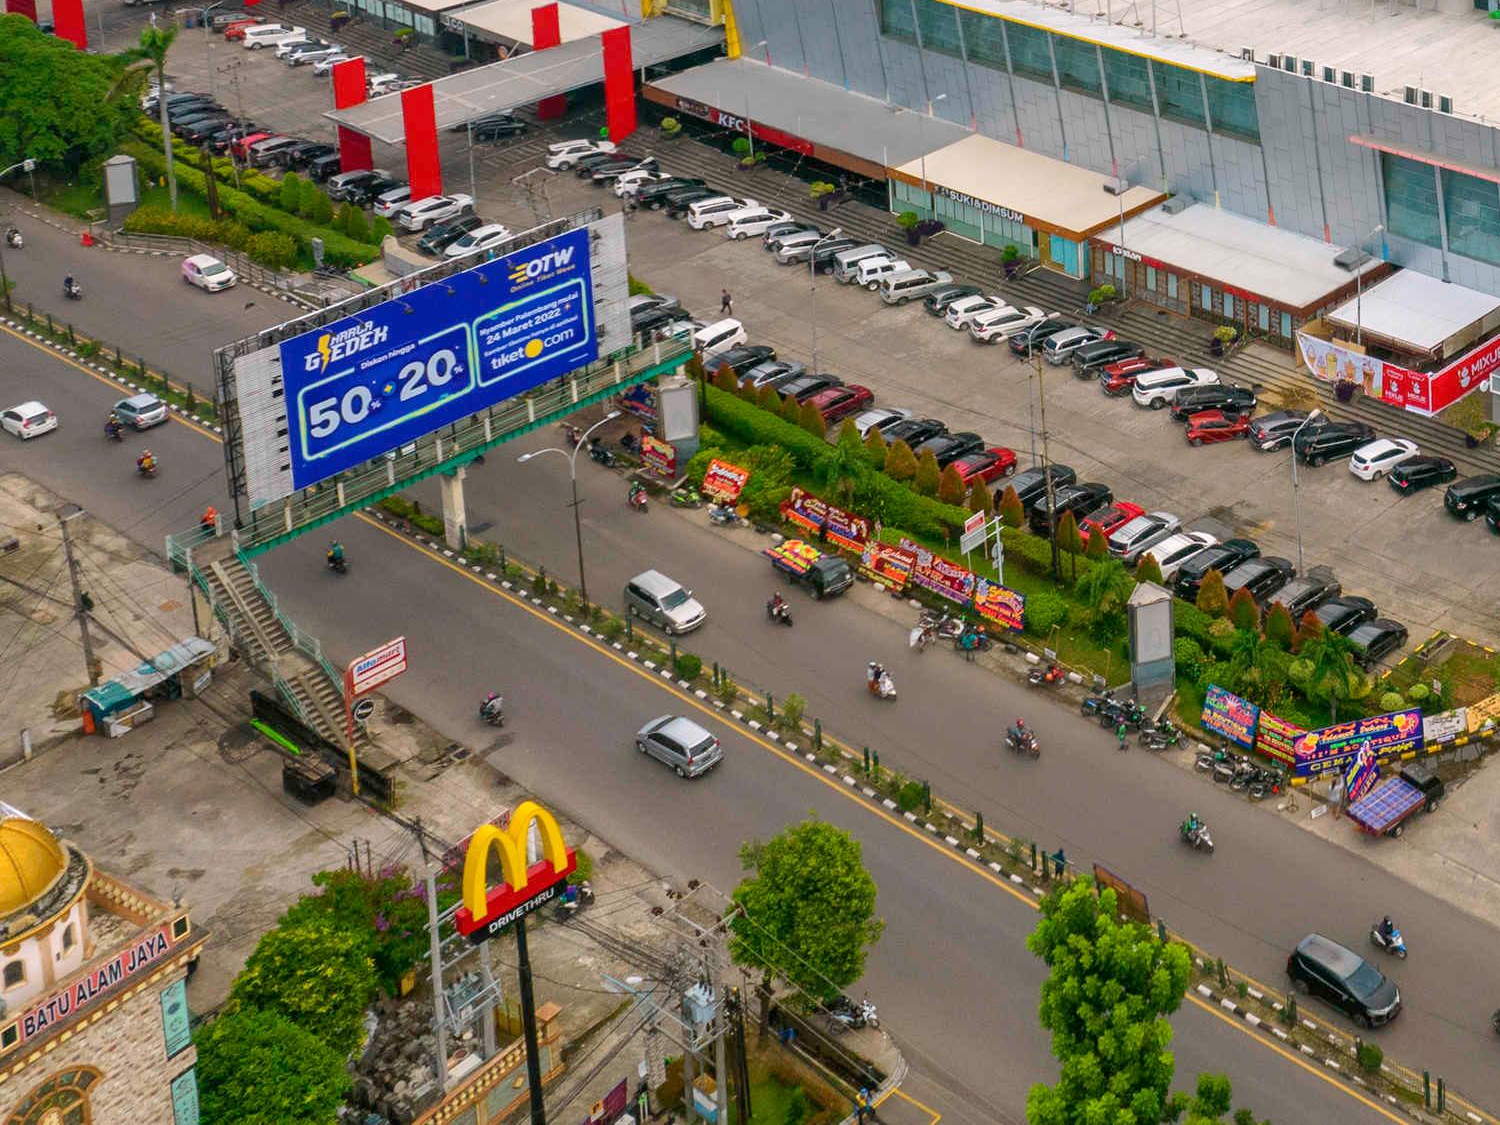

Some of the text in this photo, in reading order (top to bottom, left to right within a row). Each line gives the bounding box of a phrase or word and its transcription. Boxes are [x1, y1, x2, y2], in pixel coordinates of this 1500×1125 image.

[718, 111, 744, 132] KFC
[526, 246, 575, 278] OTW
[486, 308, 561, 345] 24 Maret 2022
[23, 932, 169, 1037] BATU ALAM JAYA
